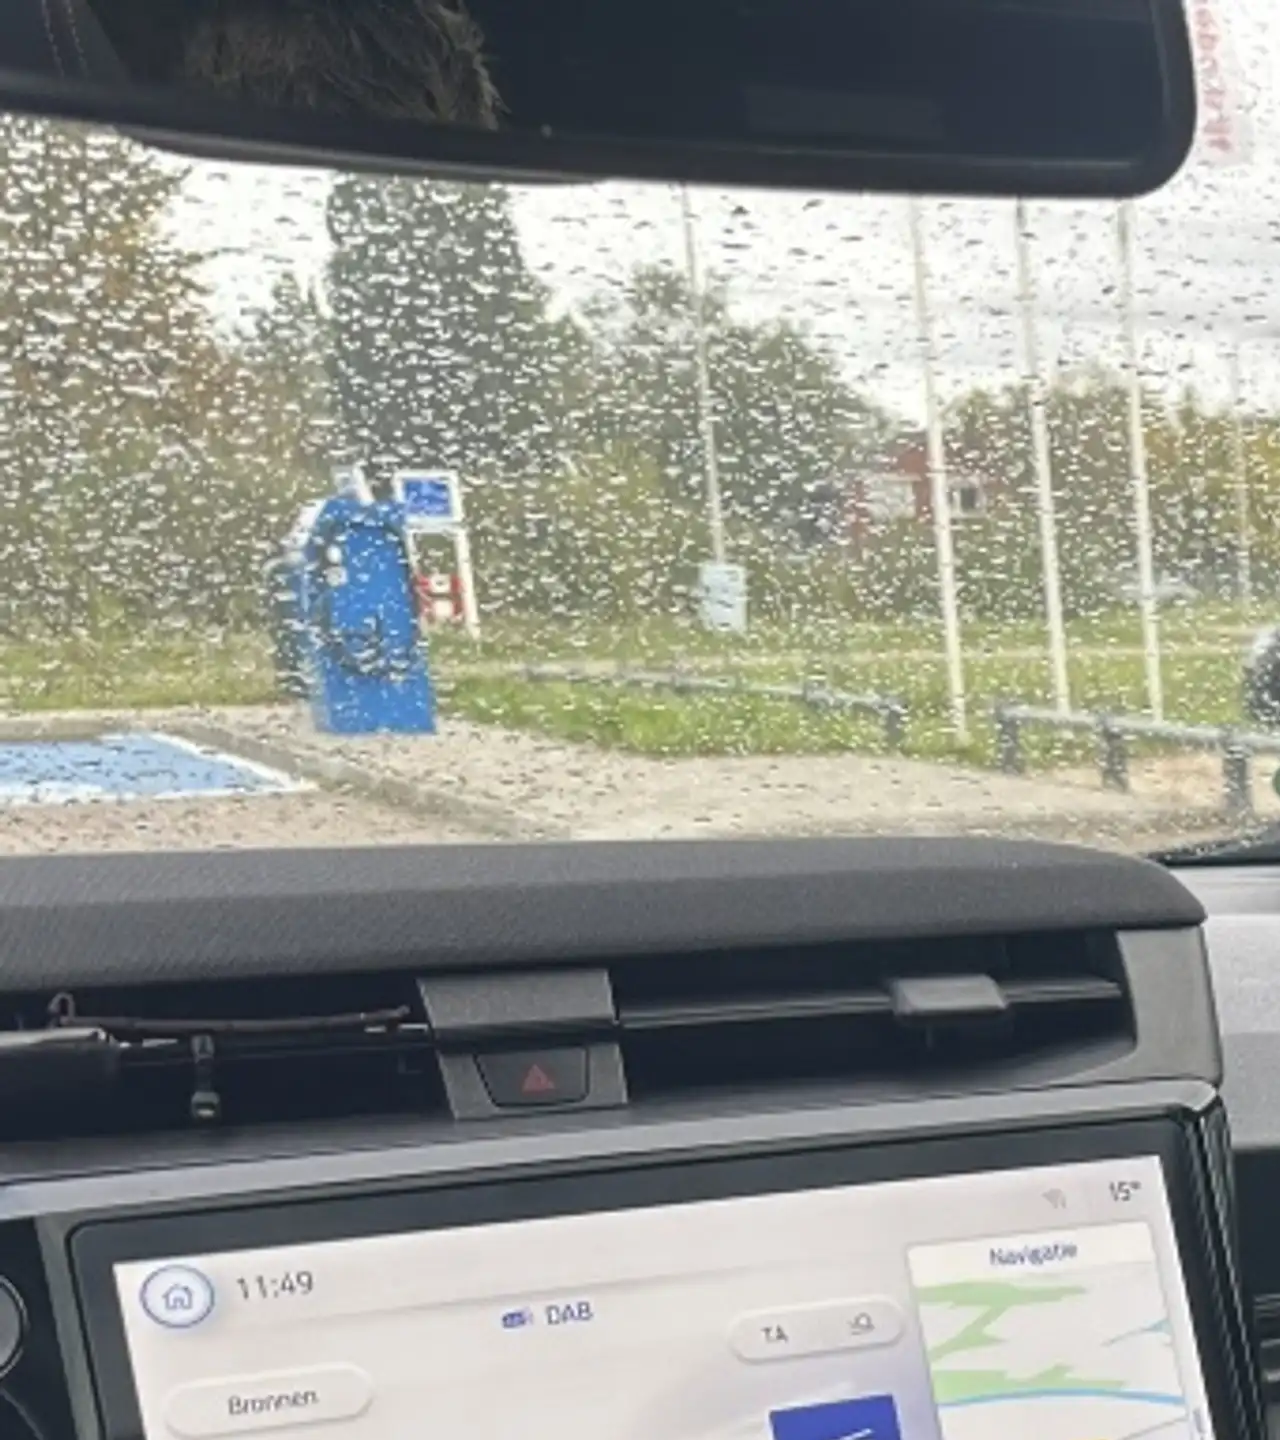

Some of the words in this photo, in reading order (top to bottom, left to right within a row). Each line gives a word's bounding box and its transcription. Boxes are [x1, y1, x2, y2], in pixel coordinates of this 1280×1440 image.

[988, 1243, 1078, 1269] Navigatie
[235, 1270, 314, 1301] 11:49
[545, 1301, 595, 1326] DAB
[761, 1324, 789, 1345] TA
[226, 1387, 319, 1417] Bronnen
